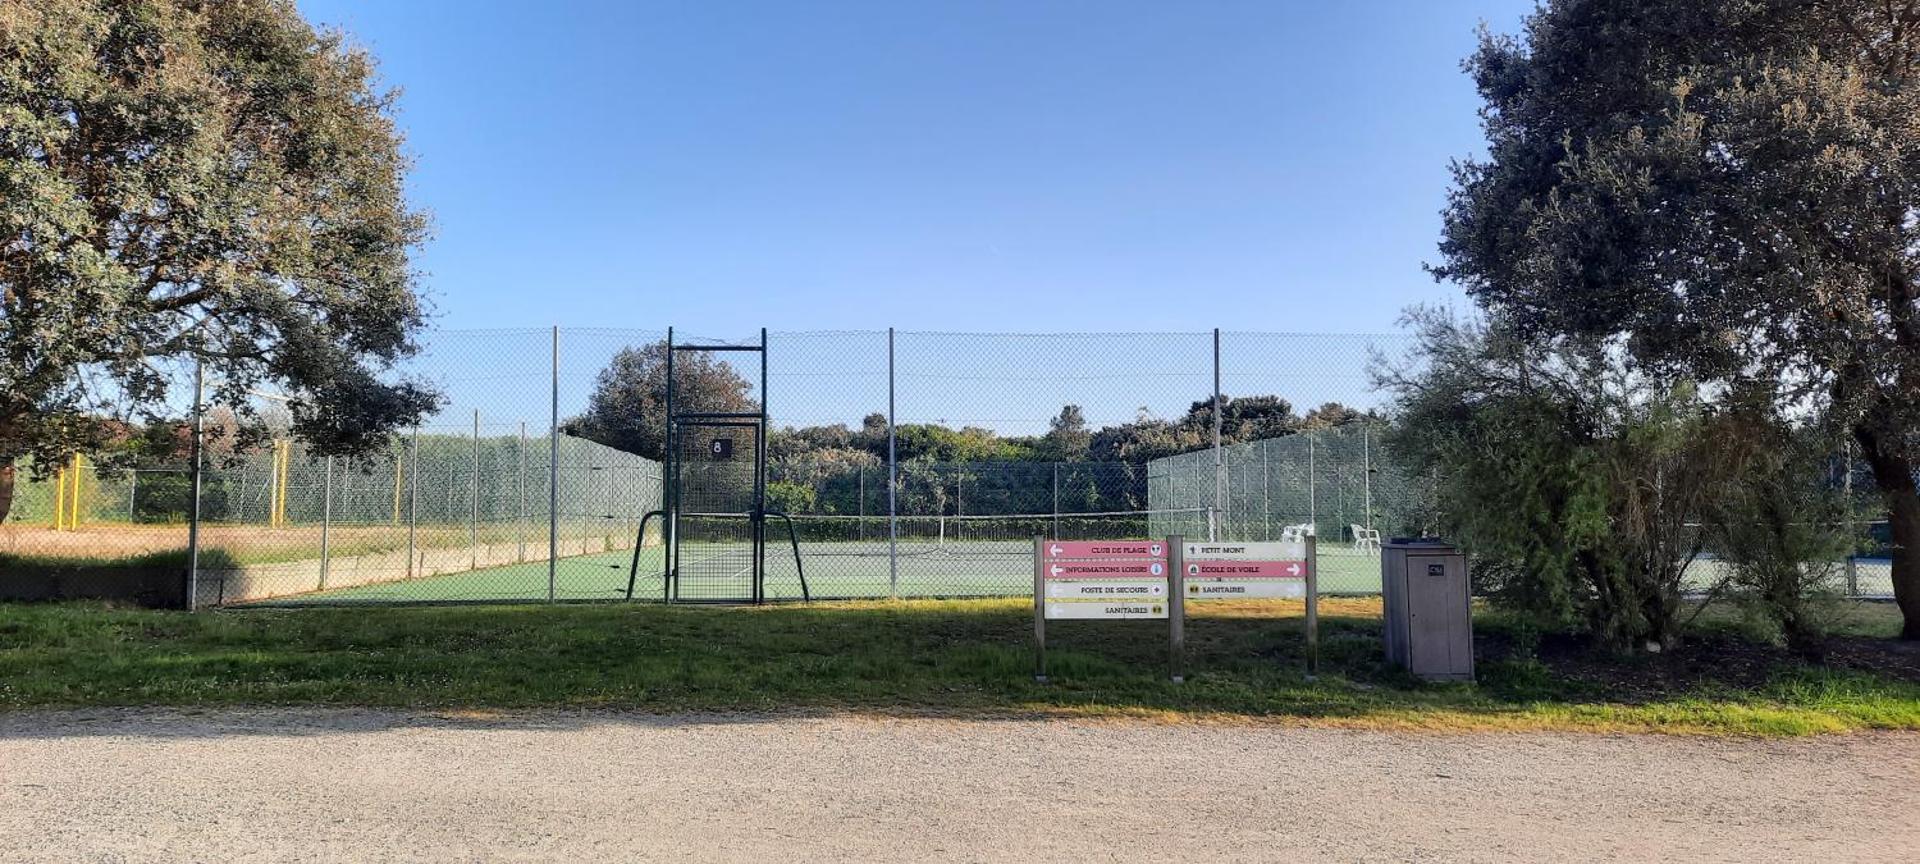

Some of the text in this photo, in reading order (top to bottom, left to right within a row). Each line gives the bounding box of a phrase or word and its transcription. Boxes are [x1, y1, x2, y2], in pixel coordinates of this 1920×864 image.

[713, 441, 722, 453] 8
[1080, 586, 1149, 594] POSTE DE SECOURS
